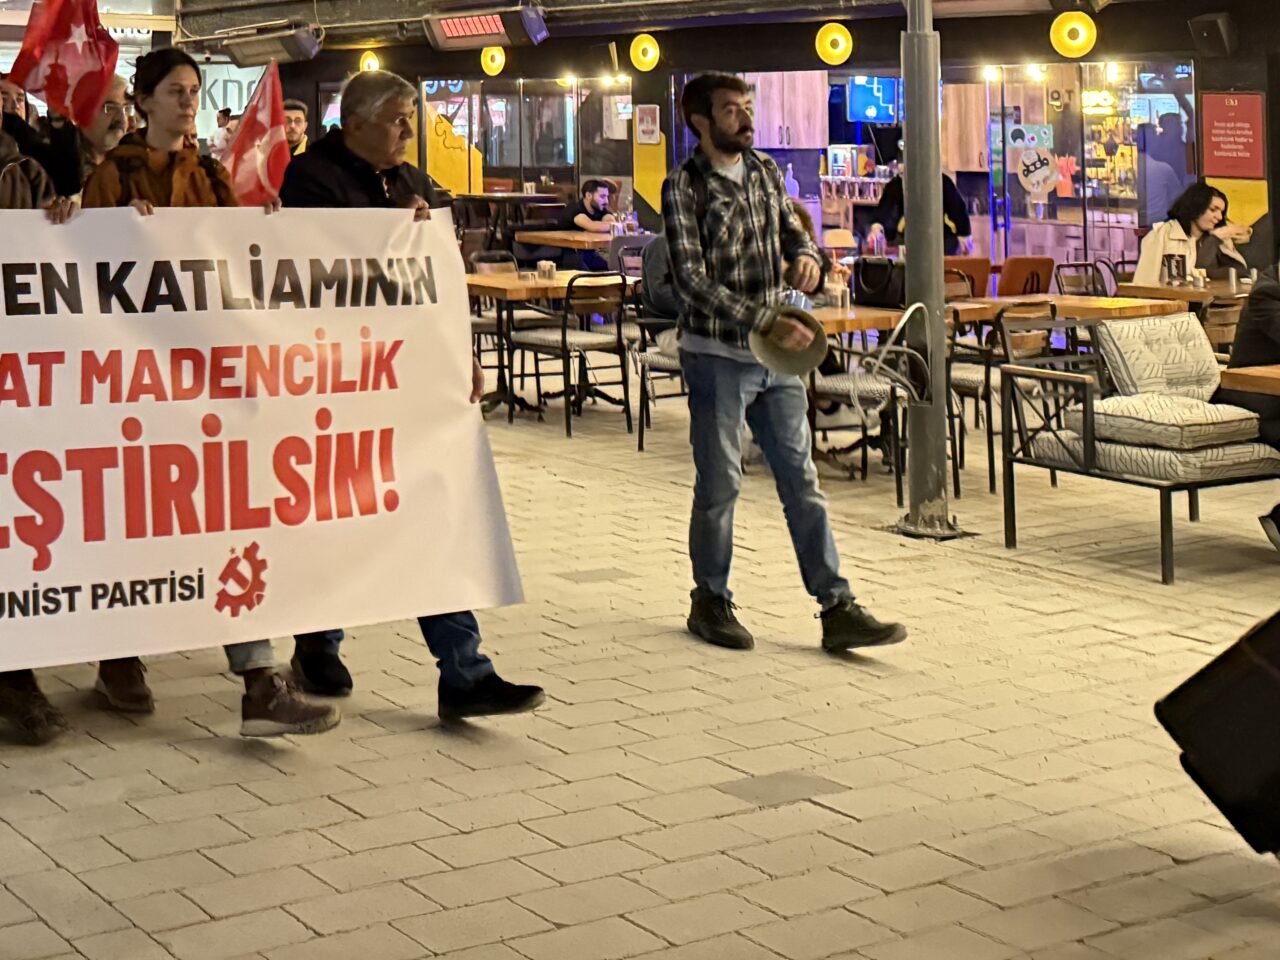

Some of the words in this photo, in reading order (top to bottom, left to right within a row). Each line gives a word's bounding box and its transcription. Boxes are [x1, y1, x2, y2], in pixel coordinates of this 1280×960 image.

[96, 243, 438, 316] KATLİAMININ
[80, 326, 405, 406] MADENCİLİK
[91, 568, 205, 614] PARTİSİ
